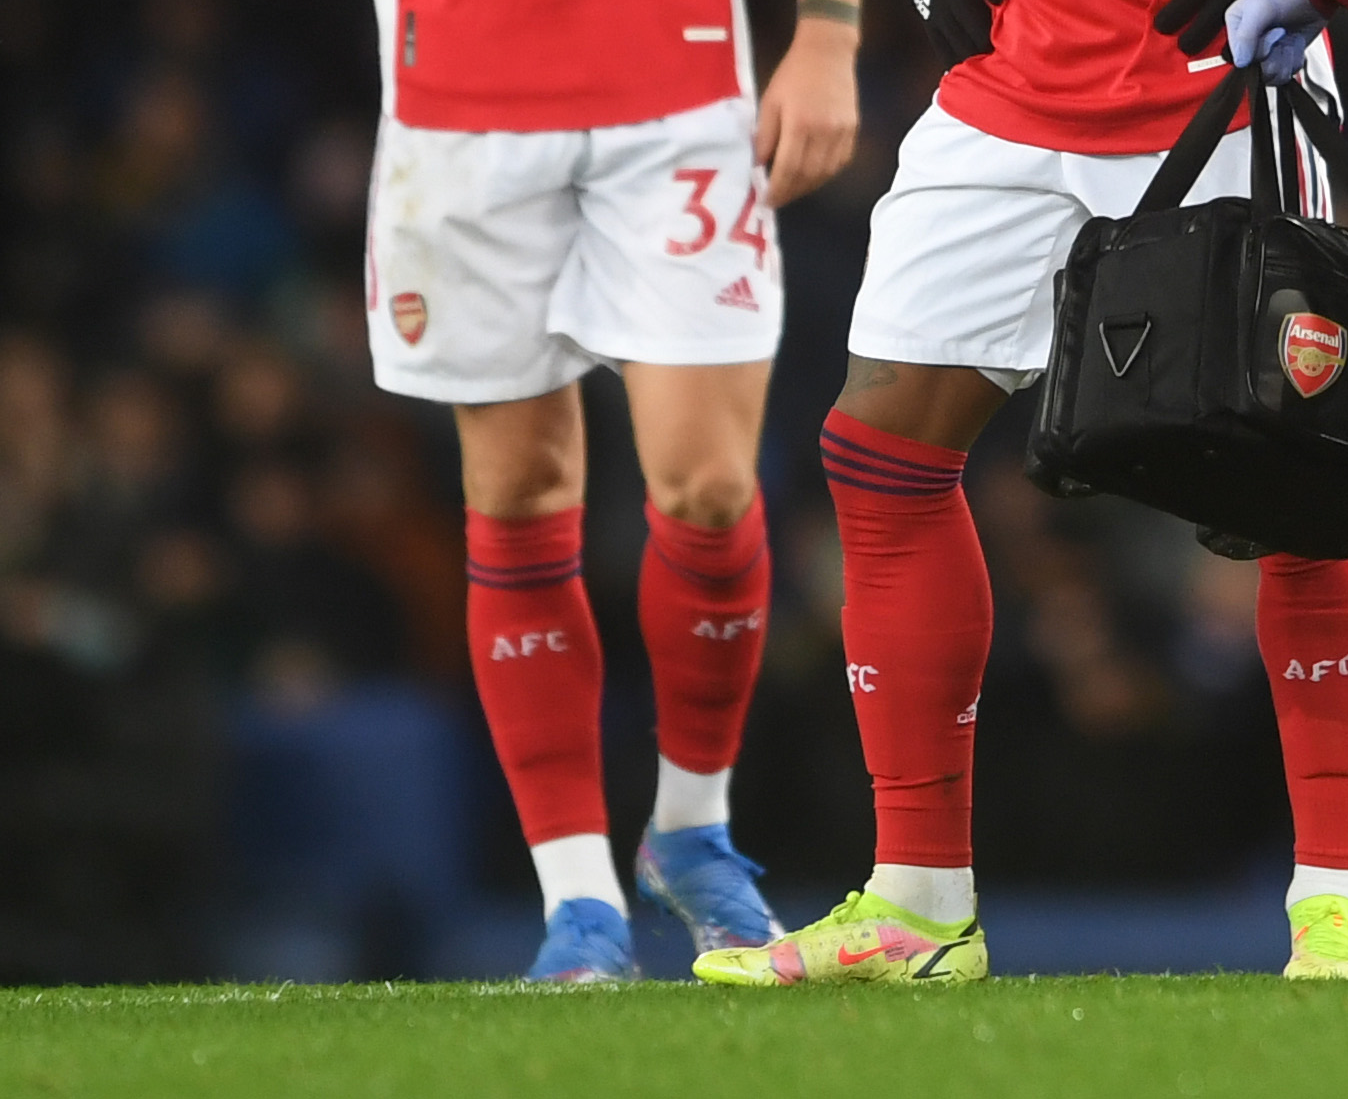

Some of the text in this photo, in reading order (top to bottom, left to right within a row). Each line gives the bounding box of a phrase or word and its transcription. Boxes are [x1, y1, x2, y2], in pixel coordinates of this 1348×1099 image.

[665, 168, 767, 272] 34
[1289, 323, 1340, 349] Arsenal
[490, 629, 569, 662] AFC
[845, 662, 880, 694] FC
